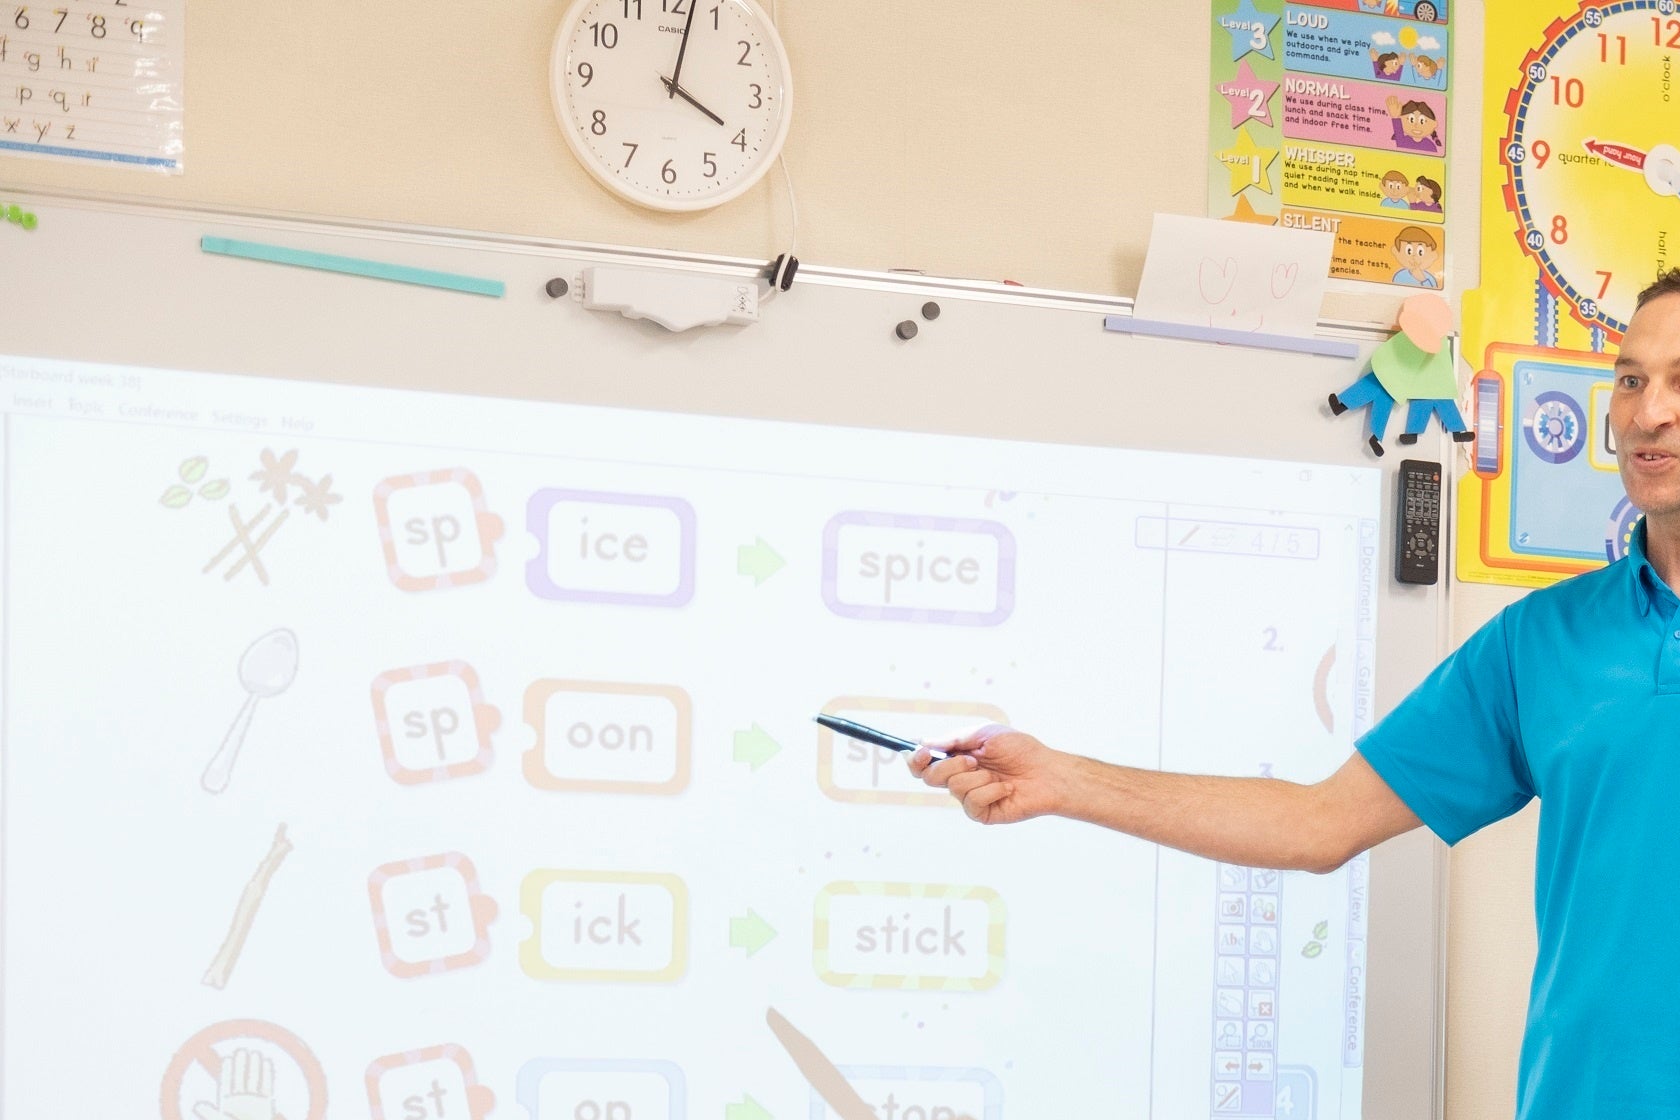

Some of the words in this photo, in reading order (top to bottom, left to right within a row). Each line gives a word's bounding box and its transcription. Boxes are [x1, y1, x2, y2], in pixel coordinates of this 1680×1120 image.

[15, 9, 30, 30] 6
[54, 11, 68, 34] 7
[91, 16, 107, 39] 8
[1286, 11, 1329, 30] LOUD
[589, 22, 619, 49] 10
[1221, 17, 1250, 31] Level
[1250, 22, 1268, 50] 3
[1286, 30, 1298, 39] We
[1301, 33, 1315, 41] use
[1318, 33, 1339, 44] when
[1341, 38, 1353, 46] we
[1354, 37, 1371, 50] play
[737, 40, 752, 67] 2
[1286, 40, 1325, 53] outdoors
[1326, 45, 1342, 55] and
[1343, 46, 1361, 58] give
[1286, 51, 1332, 63] commands.
[1597, 33, 1627, 66] 11
[577, 62, 594, 88] 9
[748, 83, 762, 109] 3
[1220, 85, 1250, 98] Level
[1249, 89, 1267, 118] 2
[1285, 78, 1352, 101] NORMAL
[1550, 76, 1585, 109] 10
[1285, 95, 1298, 105] We
[1299, 98, 1314, 107] use
[1316, 98, 1342, 111] during
[1344, 103, 1366, 114] class
[1285, 106, 1307, 117] lunch
[1309, 109, 1325, 119] and
[1326, 110, 1351, 122] snack
[1352, 113, 1372, 124] time
[591, 110, 607, 136] 8
[1285, 115, 1301, 125] and
[1302, 117, 1329, 128] indoor
[1331, 120, 1350, 131] free
[1352, 122, 1374, 134] time.
[731, 127, 748, 152] 4
[622, 142, 639, 168] 7
[703, 152, 717, 178] 5
[1220, 153, 1250, 166] Level
[1284, 146, 1357, 168] WHISPER
[1531, 140, 1551, 169] 9
[1558, 151, 1601, 167] quarter
[661, 159, 677, 184] 6
[1284, 161, 1297, 170] We
[1298, 164, 1313, 172] use
[1315, 164, 1342, 177] during
[1343, 168, 1359, 179] nap
[1284, 171, 1306, 183] quiet
[1308, 174, 1339, 186] reading
[1341, 177, 1360, 187] time
[1284, 181, 1299, 190] and
[1301, 182, 1323, 193] when
[1324, 187, 1336, 195] we
[1338, 186, 1356, 196] walk
[1358, 188, 1383, 200] inside.
[1283, 212, 1342, 234] SILENT
[1550, 215, 1568, 245] 8
[1338, 236, 1353, 246] the
[1355, 239, 1387, 250] teacher
[1350, 258, 1365, 267] and
[1595, 271, 1612, 300] 7
[403, 512, 461, 569] sp
[579, 516, 650, 563] ice
[857, 540, 981, 604] spice
[402, 705, 460, 761] sp
[566, 717, 654, 753] oon
[406, 893, 450, 938] st
[572, 893, 644, 946] ick
[856, 906, 967, 957] stick
